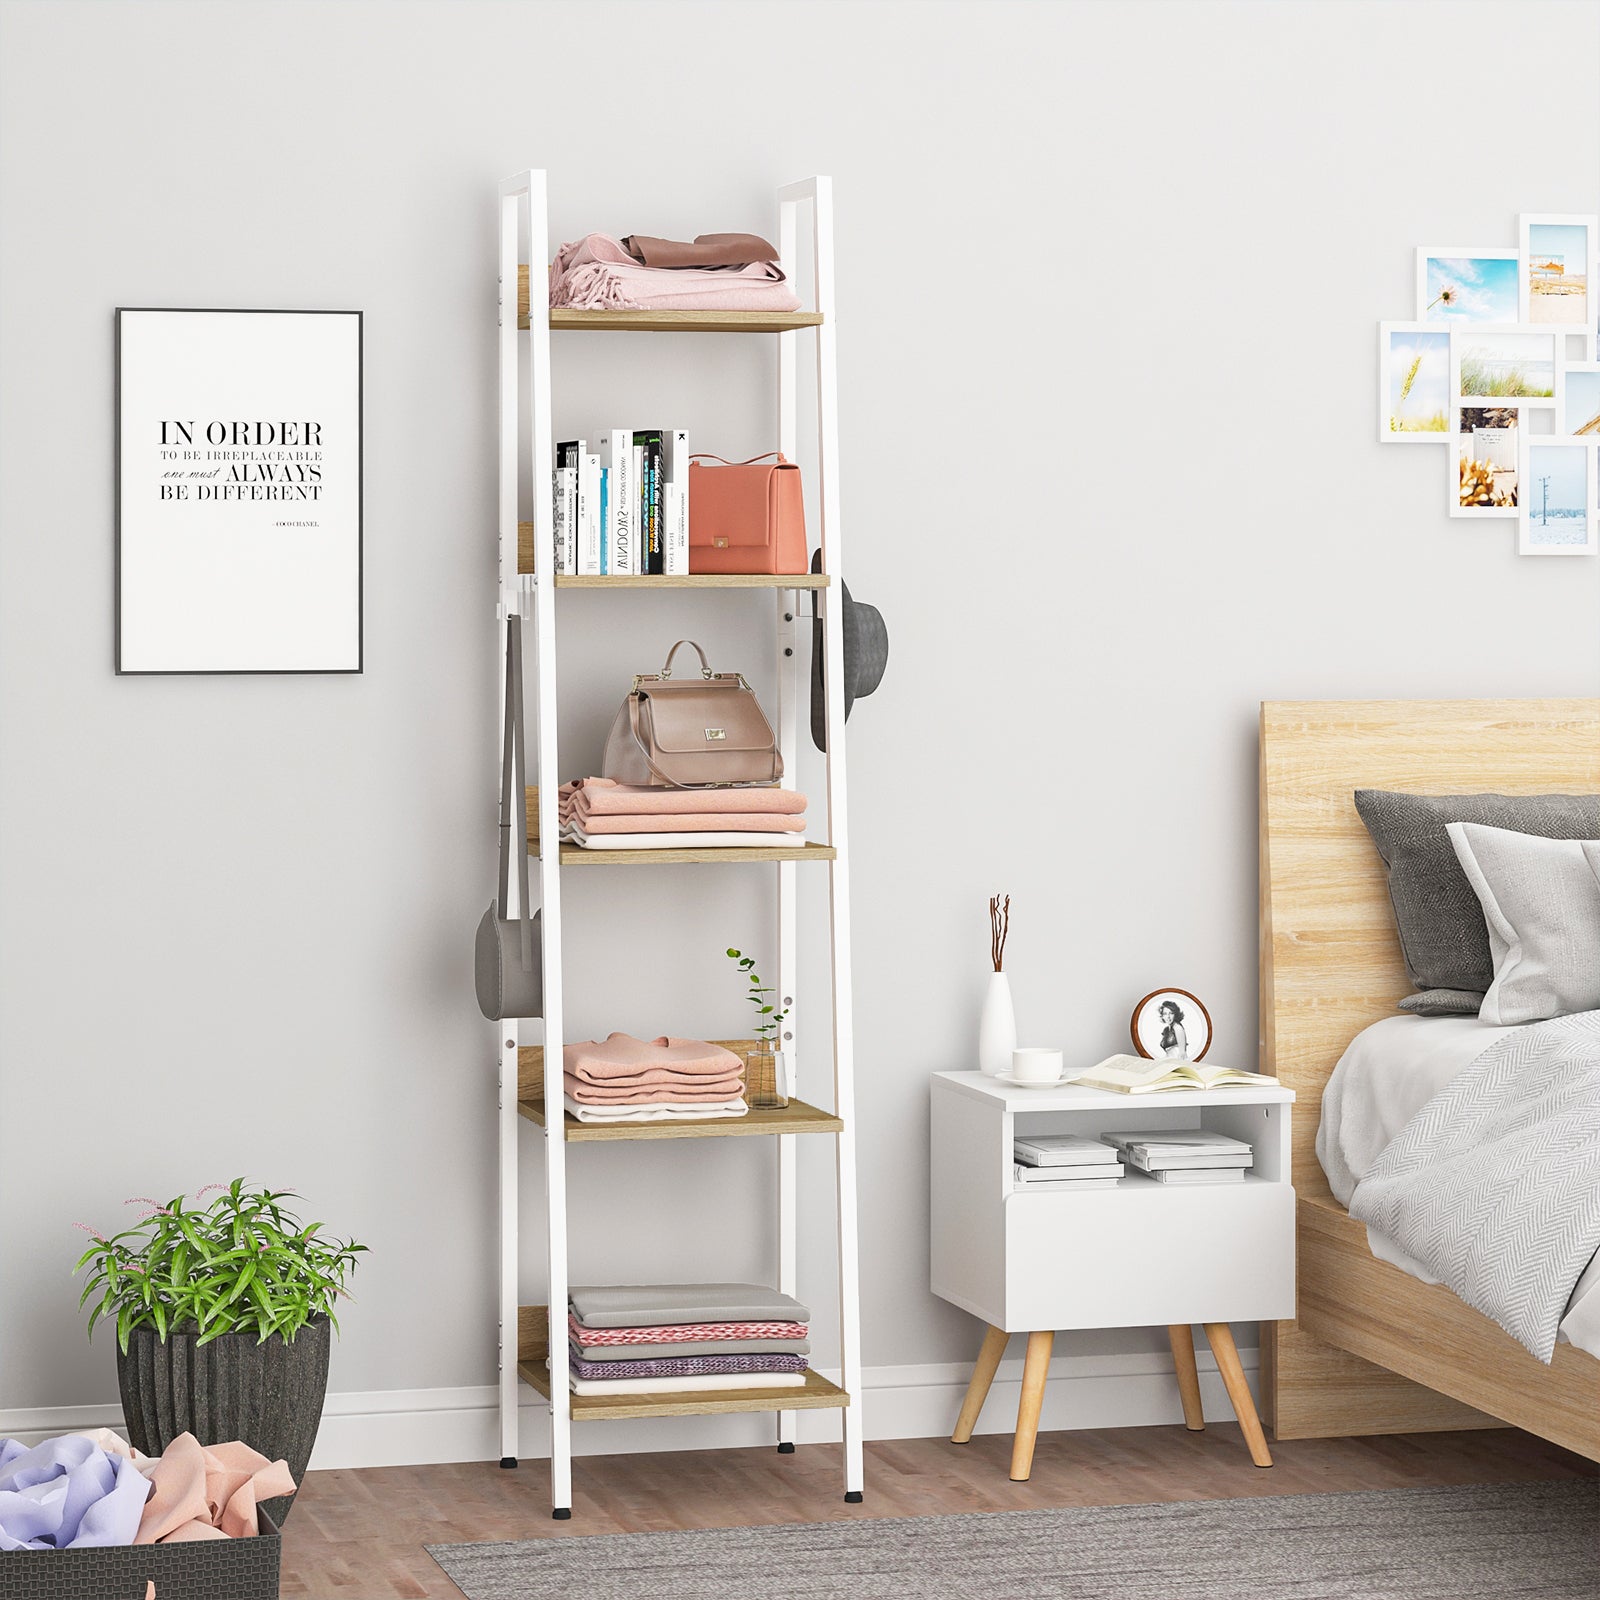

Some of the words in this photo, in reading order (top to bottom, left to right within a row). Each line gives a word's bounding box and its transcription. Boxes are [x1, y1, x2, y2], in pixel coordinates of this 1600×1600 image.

[157, 420, 196, 445] IN
[206, 420, 323, 446] ORDER
[160, 450, 178, 460] TO
[183, 450, 201, 460] BE
[207, 450, 323, 461] IRREPLACEABLE
[160, 470, 187, 479] one
[186, 466, 221, 479] must
[226, 463, 322, 483] ALWAYS
[159, 484, 189, 501] BE
[197, 484, 323, 501] DIFFERENT
